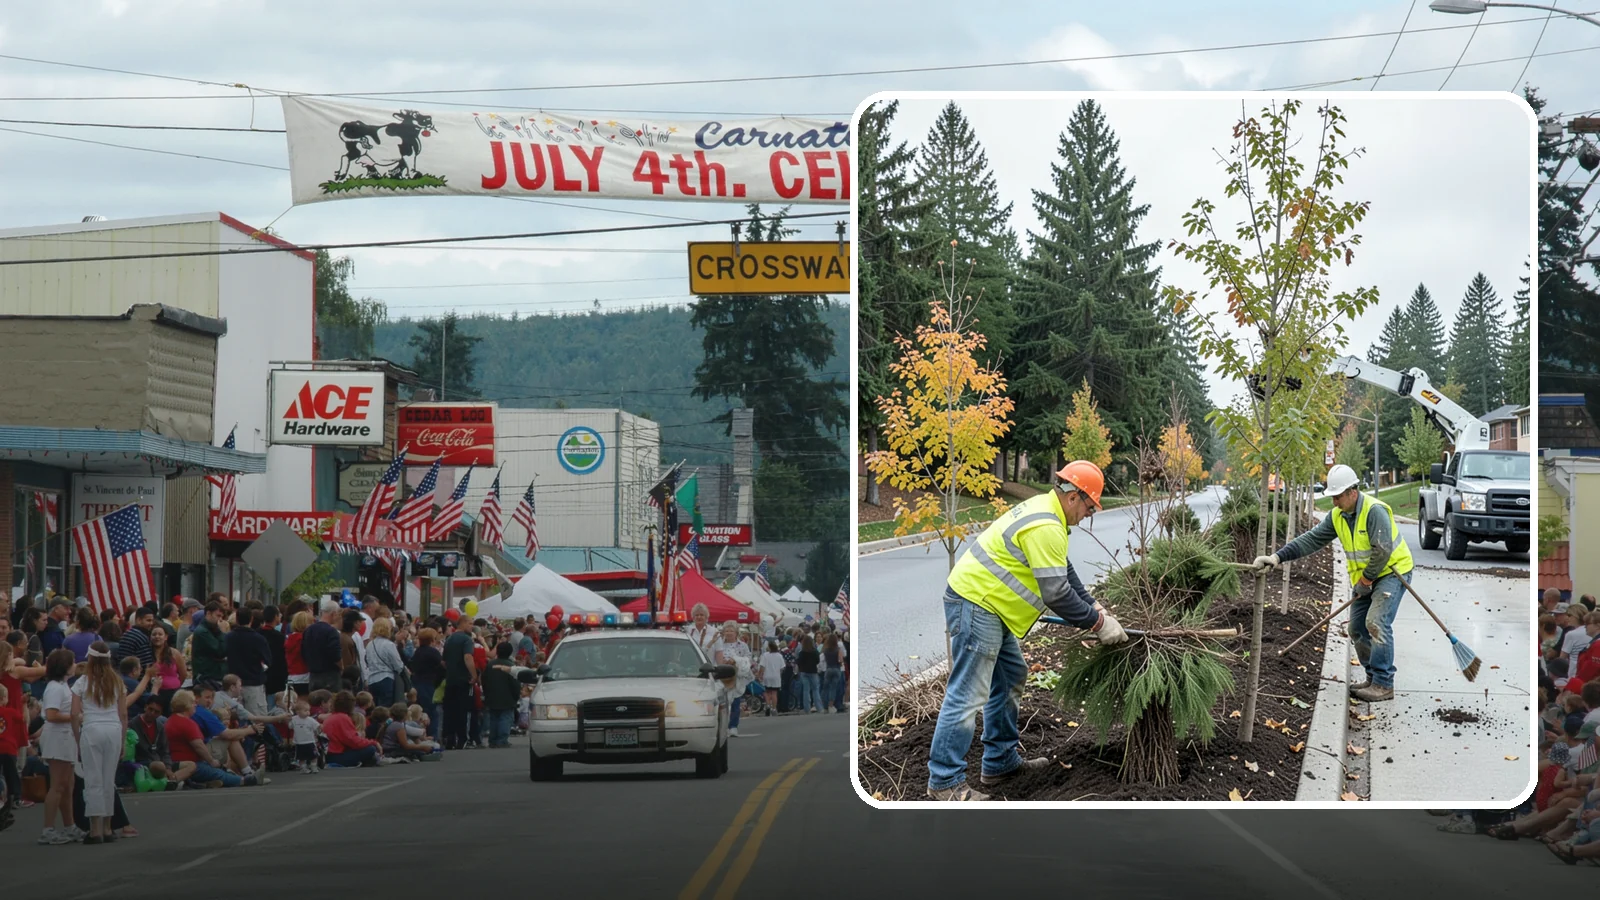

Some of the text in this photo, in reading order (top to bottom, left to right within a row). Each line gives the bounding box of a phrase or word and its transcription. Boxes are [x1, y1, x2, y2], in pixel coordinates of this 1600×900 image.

[481, 140, 605, 192] JULY
[632, 150, 746, 198] 4th.
[697, 254, 850, 280] CROSSWA
[282, 379, 373, 420] ACE
[406, 409, 452, 421] CEDAR
[283, 421, 371, 436] Hardware
[416, 428, 477, 447] Coca-Cola
[353, 467, 385, 480] Simpl
[83, 485, 155, 495] St. Vincent de Paul
[688, 526, 741, 535] CRNATION
[699, 535, 730, 543] GLASS
